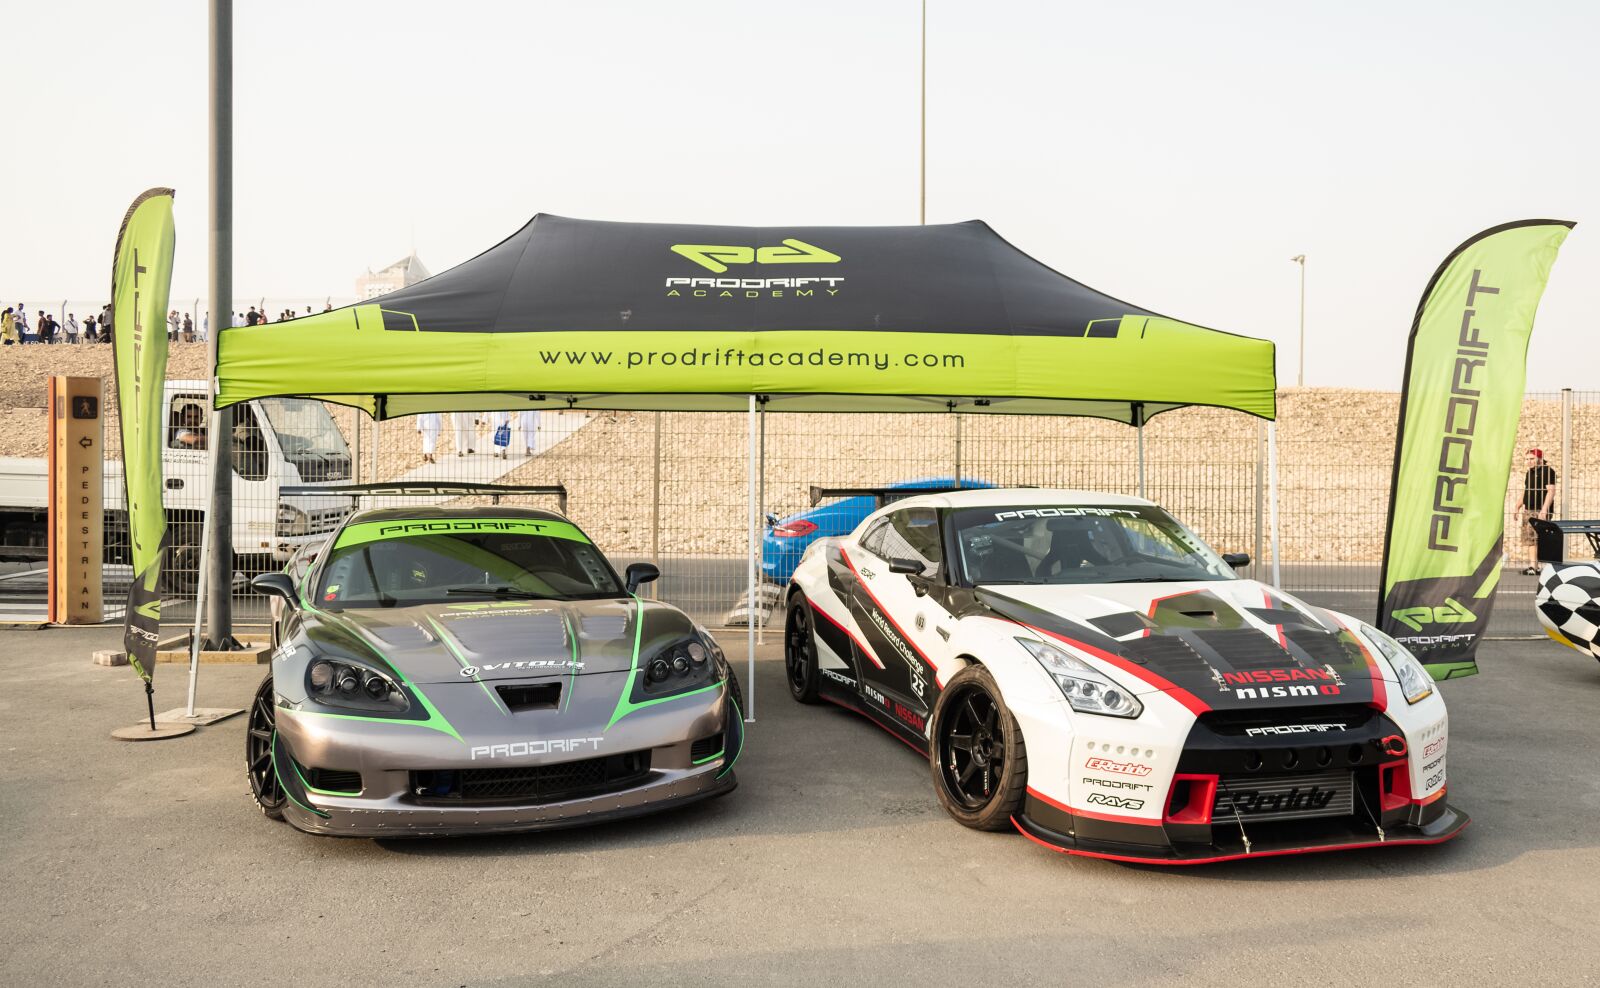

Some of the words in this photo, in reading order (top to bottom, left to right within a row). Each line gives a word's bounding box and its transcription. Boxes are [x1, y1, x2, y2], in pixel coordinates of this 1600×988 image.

[666, 277, 845, 288] PRODRIFT
[667, 289, 839, 298] ACADEMY
[539, 348, 965, 370] www.prodriftacademy.com
[1428, 269, 1500, 552] PRODRIFT
[994, 507, 1141, 522] PRODRIFT
[379, 522, 548, 535] PRODRIFT
[81, 466, 89, 609] PEDESTRIAN
[1410, 642, 1471, 652] CAEMY
[483, 660, 585, 671] VITOUR
[899, 641, 924, 675] Challenge
[822, 667, 857, 688] PRODRIFT
[1222, 667, 1332, 685] NISSAN
[912, 673, 925, 697] 23
[895, 702, 925, 731] NISSAN
[1245, 723, 1347, 737] PRODRIFT
[471, 737, 604, 760] PRODRIFT
[1082, 777, 1154, 792] PRODRIFT
[1086, 793, 1145, 810] RAYS
